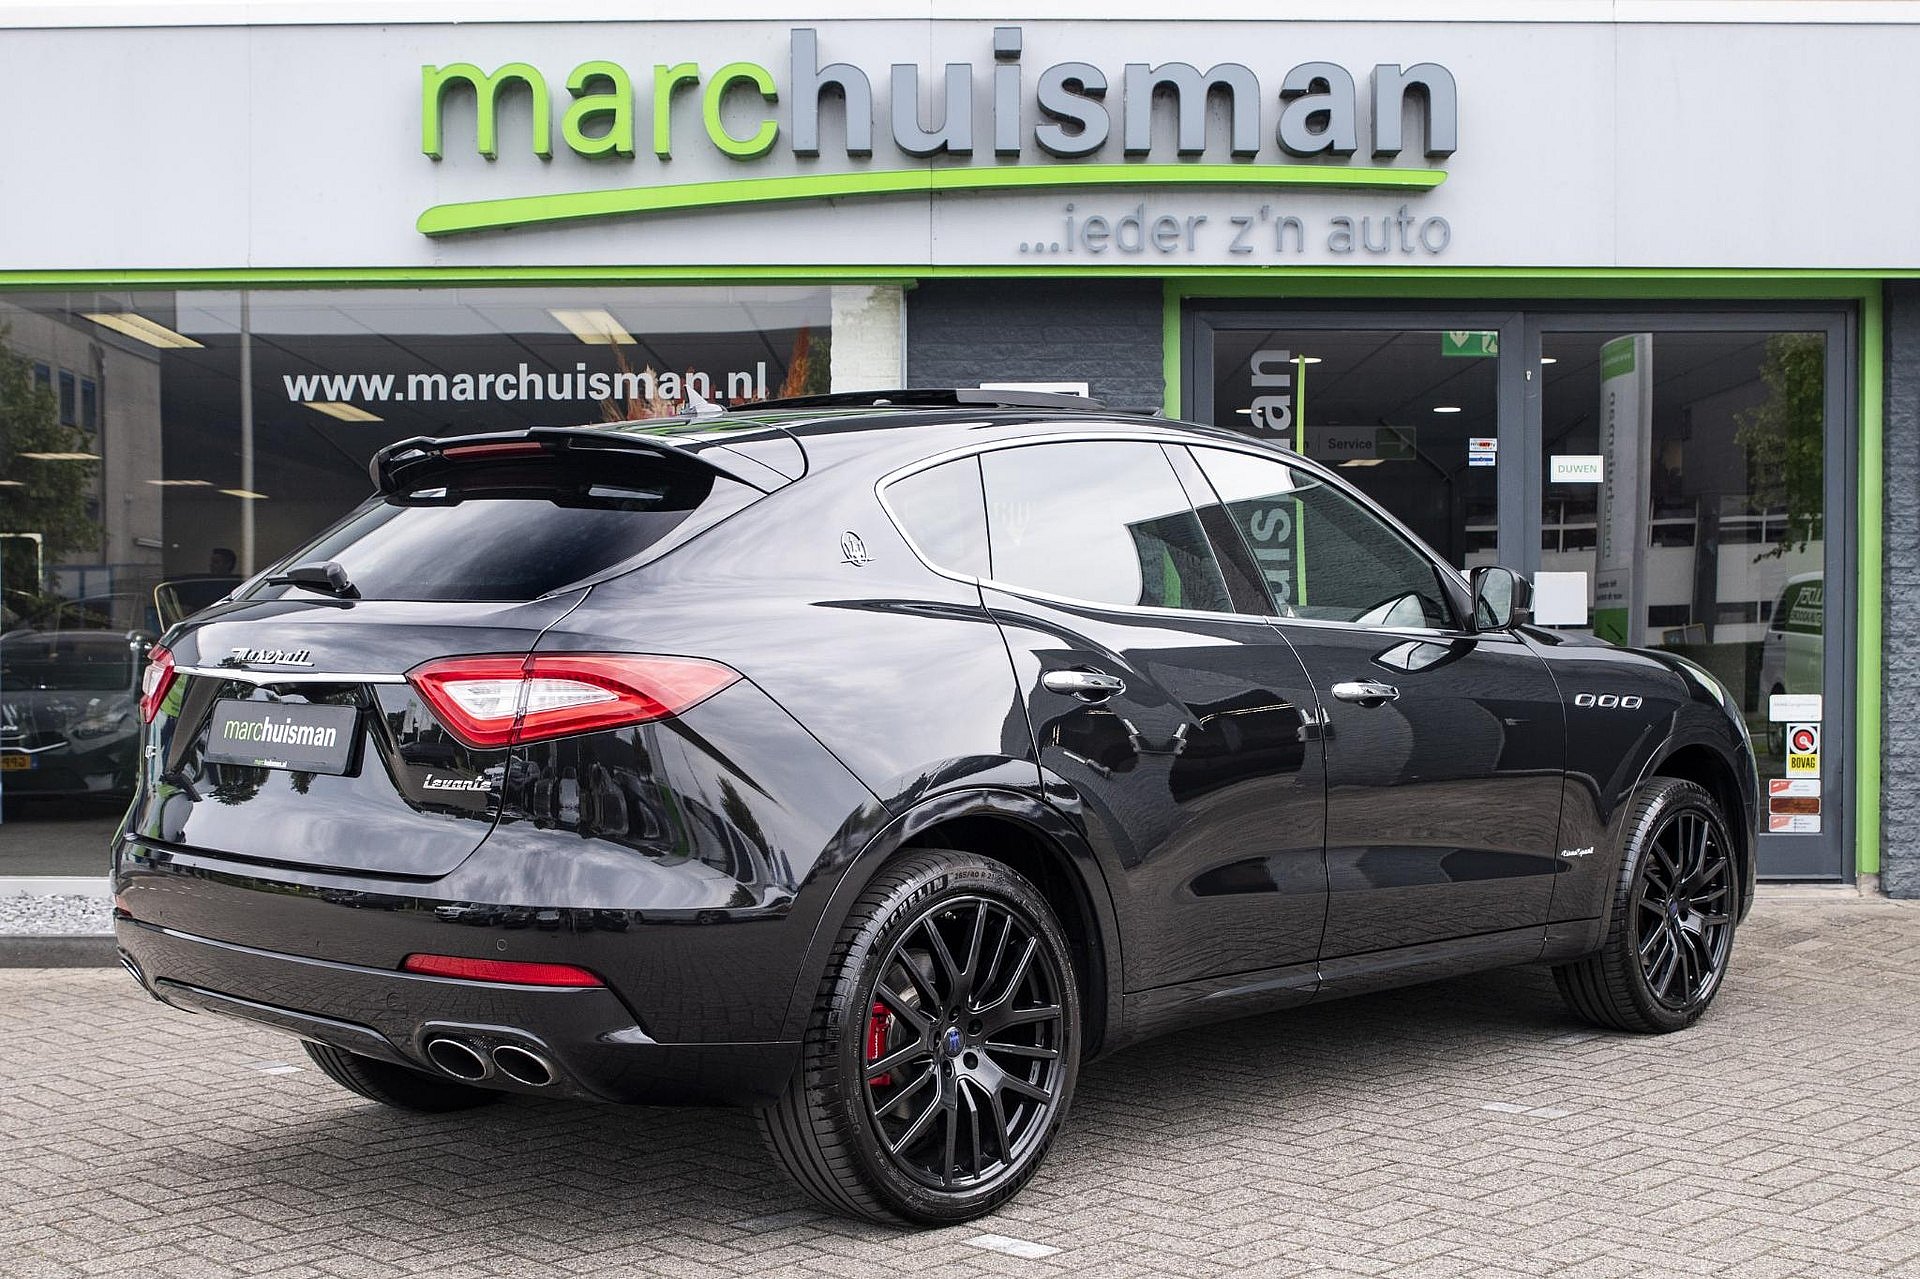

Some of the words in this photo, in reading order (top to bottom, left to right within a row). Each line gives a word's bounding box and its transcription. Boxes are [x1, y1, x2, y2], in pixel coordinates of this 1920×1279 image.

[421, 27, 1458, 160] marchuisman
[1229, 204, 1304, 253] z'n
[1327, 204, 1452, 254] auto
[282, 361, 767, 402] www.marchuisman.nl
[1328, 438, 1373, 450] Service
[1558, 464, 1598, 474] DUWEN
[223, 716, 337, 748] marchuisman
[1791, 757, 1816, 769] BOVAG
[423, 773, 492, 791] Levante
